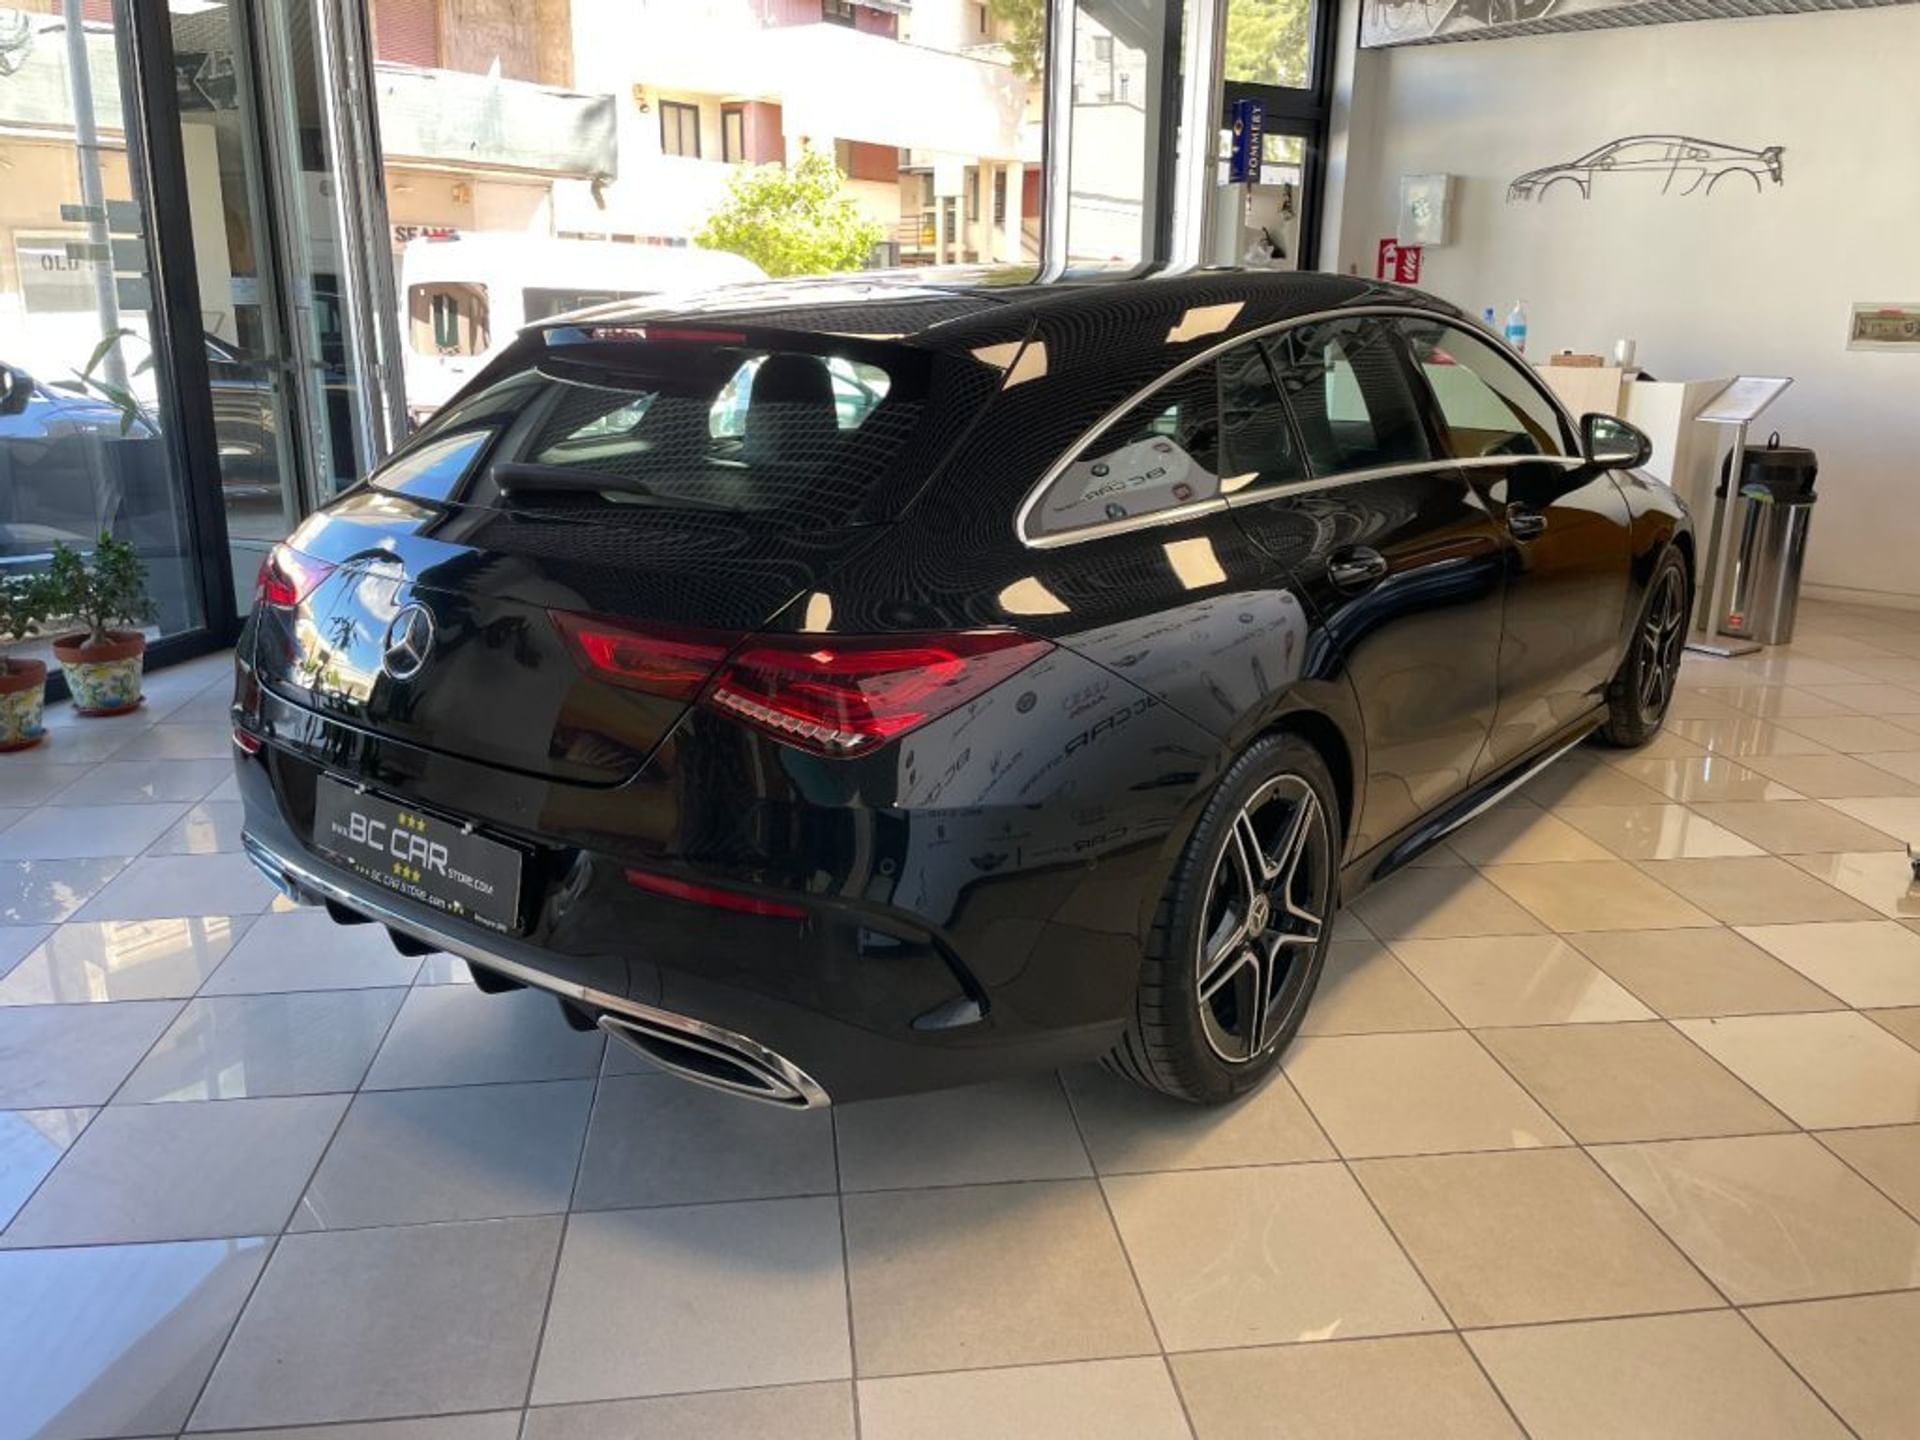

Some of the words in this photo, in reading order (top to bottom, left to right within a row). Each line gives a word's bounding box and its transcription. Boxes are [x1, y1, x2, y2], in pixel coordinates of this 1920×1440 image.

[1248, 105, 1262, 176] POMMERY
[349, 812, 387, 851] BC
[390, 828, 448, 877] CAR
